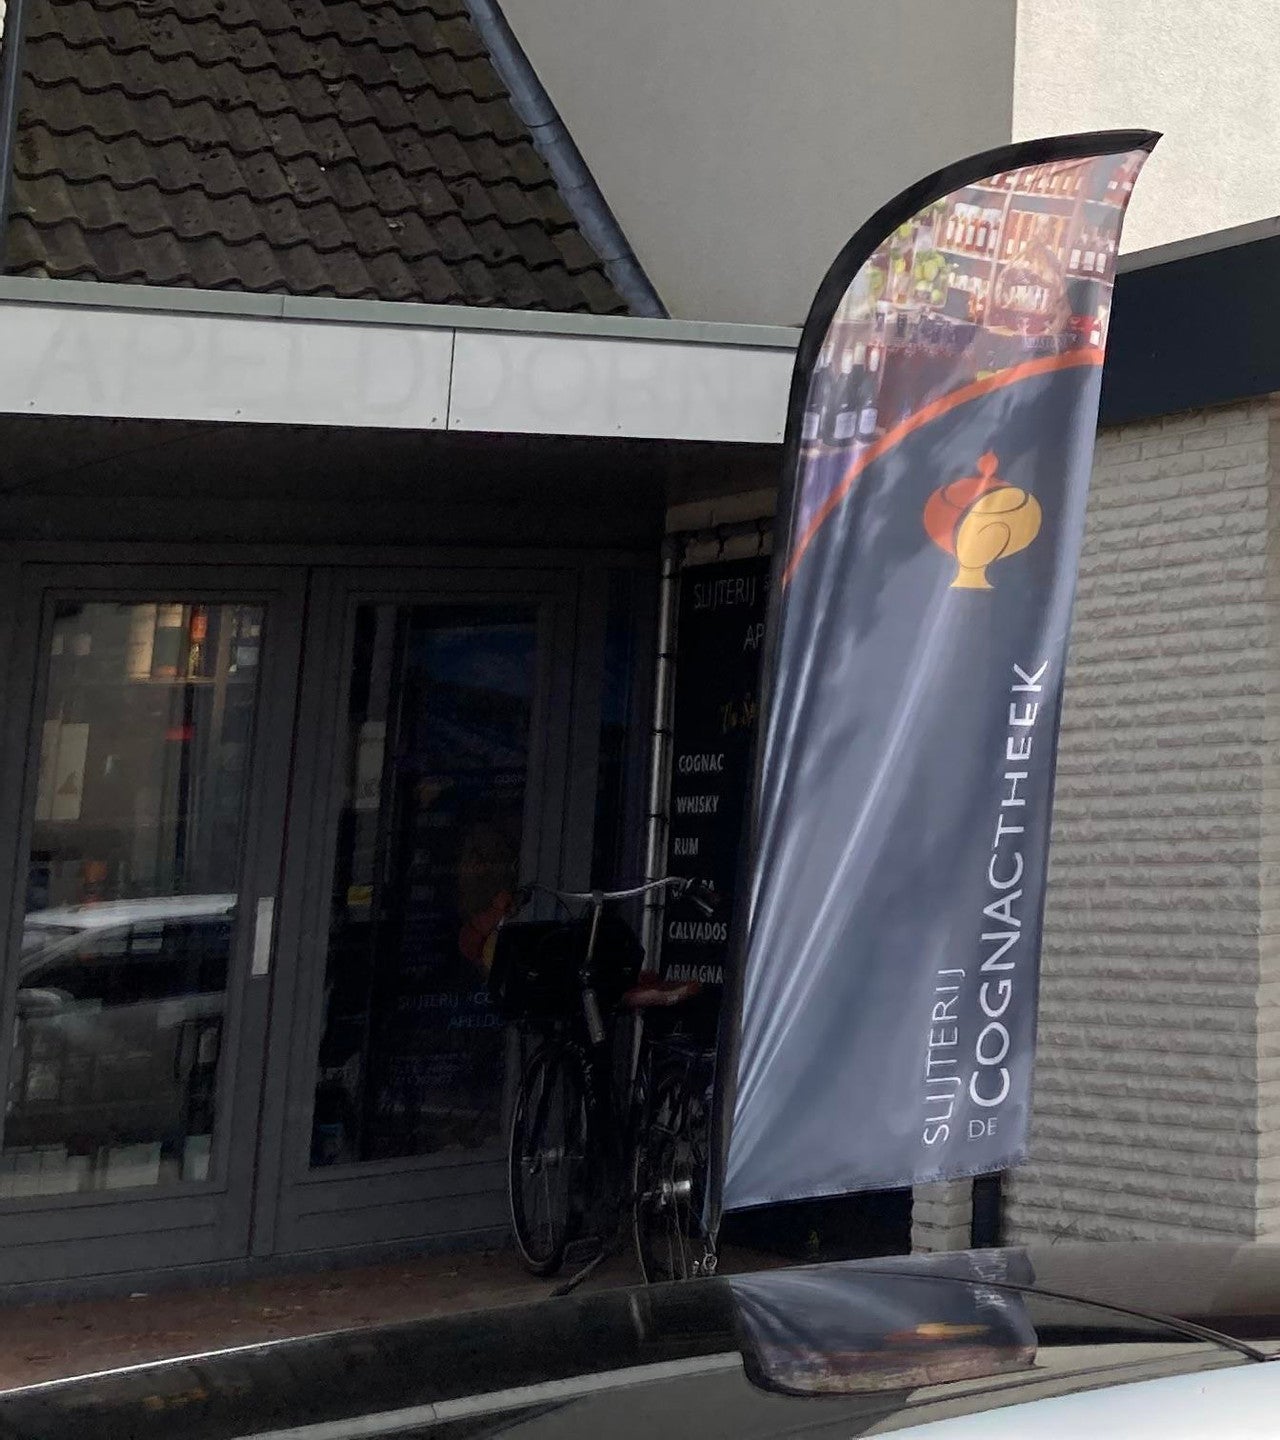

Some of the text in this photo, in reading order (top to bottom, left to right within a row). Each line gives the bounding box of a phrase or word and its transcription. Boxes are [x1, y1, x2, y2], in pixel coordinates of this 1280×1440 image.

[693, 576, 757, 610] SLIJTERIJ
[678, 753, 725, 773] COGNAC
[676, 795, 720, 815] WHISKY
[674, 837, 699, 856] RUM
[969, 660, 1049, 1139] DE COGNACTHEEK
[668, 921, 728, 941] CALVADOS
[665, 963, 724, 984] ARMAGNA
[922, 968, 966, 1145] SLIJTERIJ
